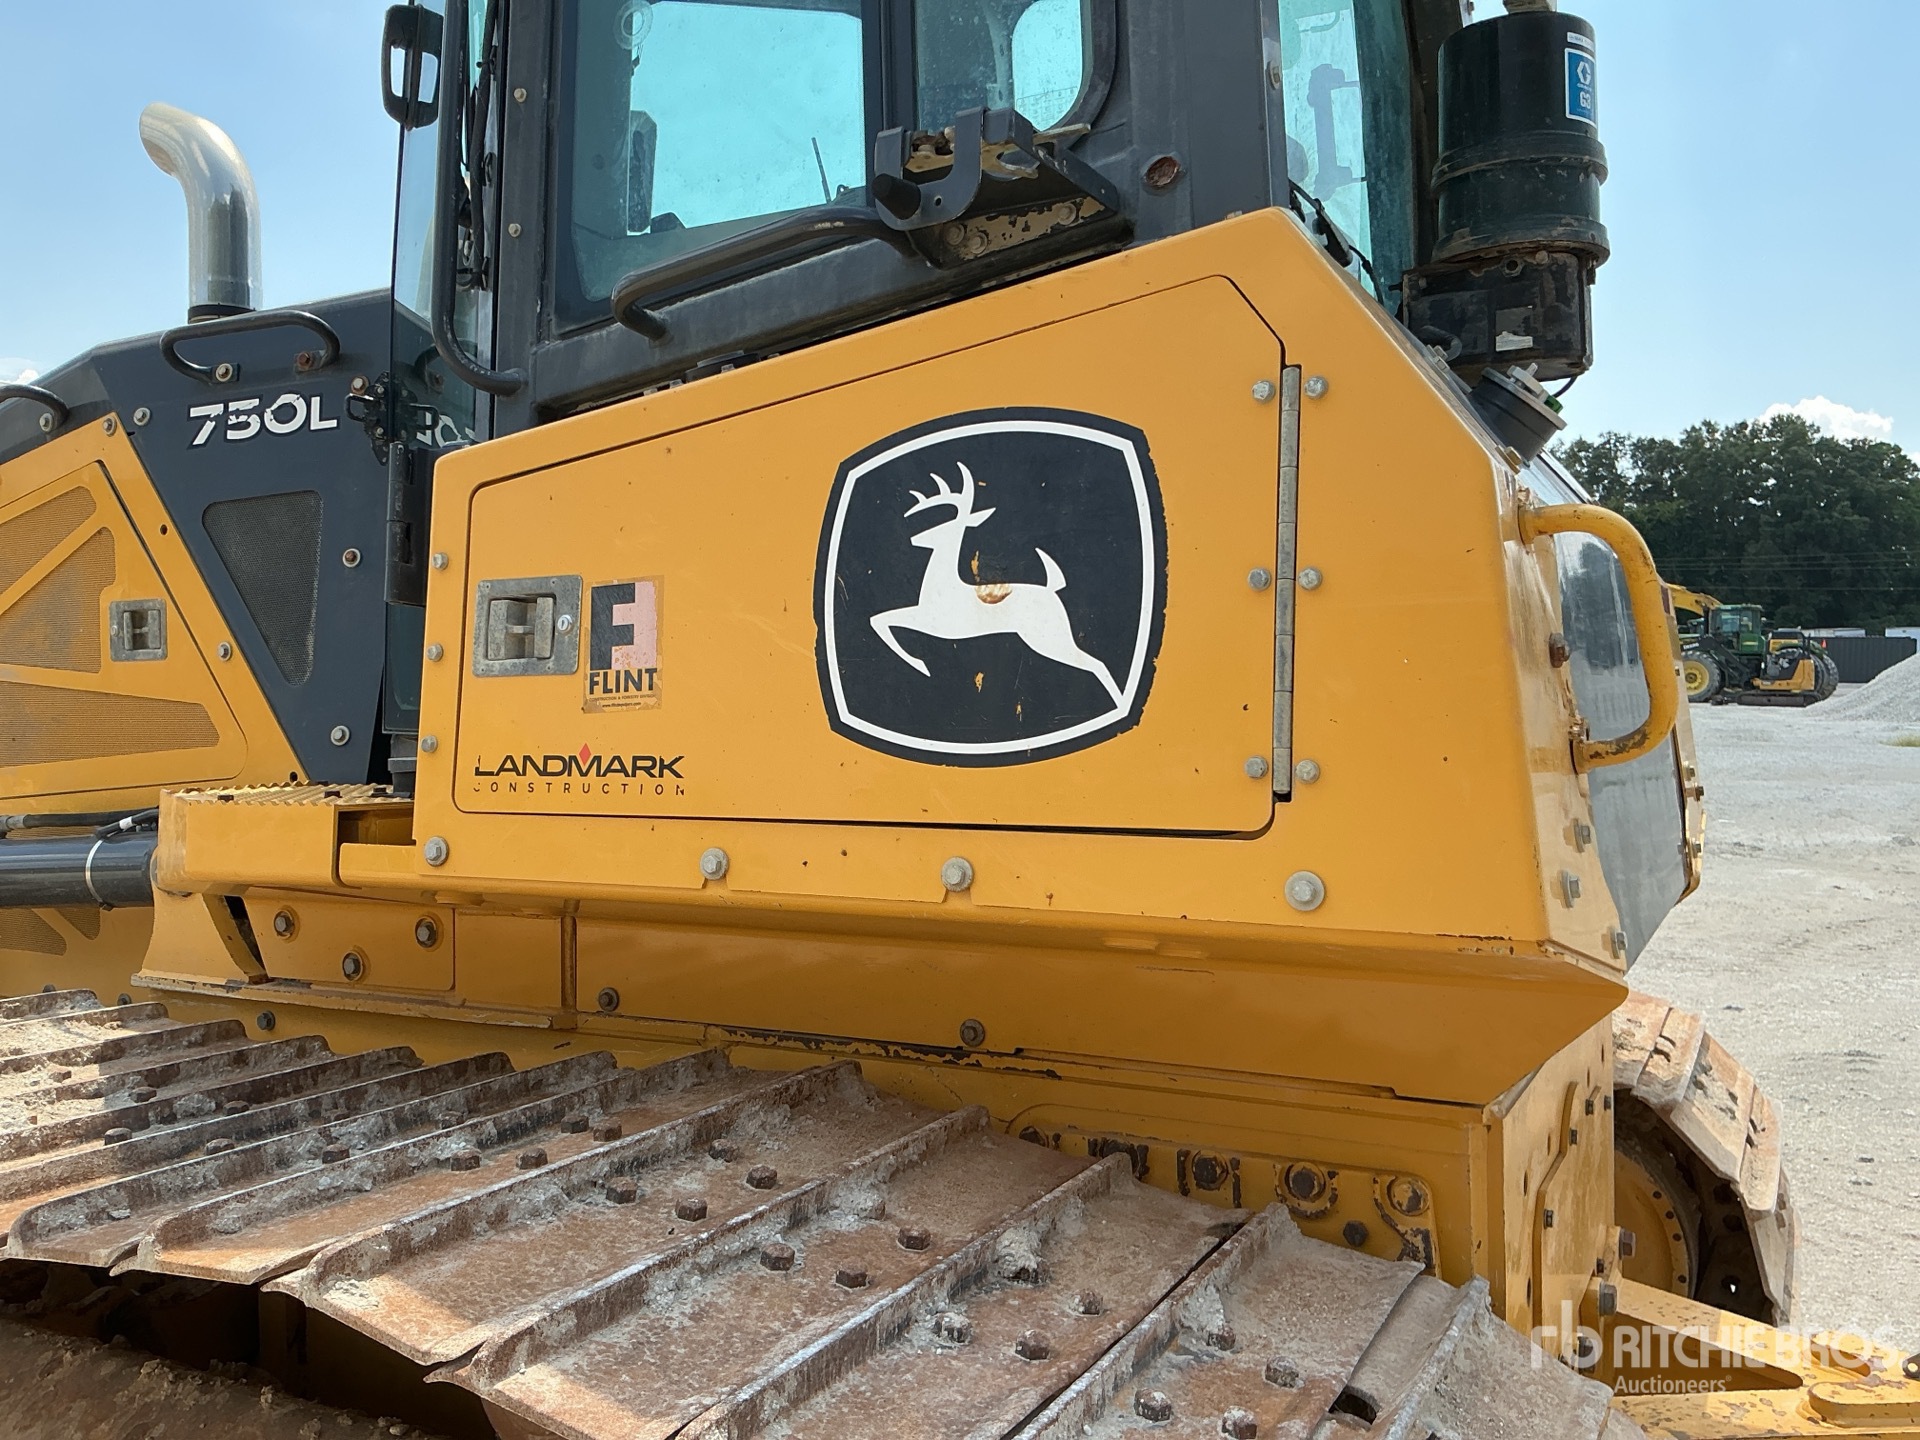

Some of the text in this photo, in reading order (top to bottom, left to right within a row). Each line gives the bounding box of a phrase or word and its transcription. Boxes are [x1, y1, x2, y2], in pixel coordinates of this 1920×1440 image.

[189, 393, 338, 446] 750L
[589, 668, 658, 695] FLINT
[474, 754, 685, 778] LANDMARK
